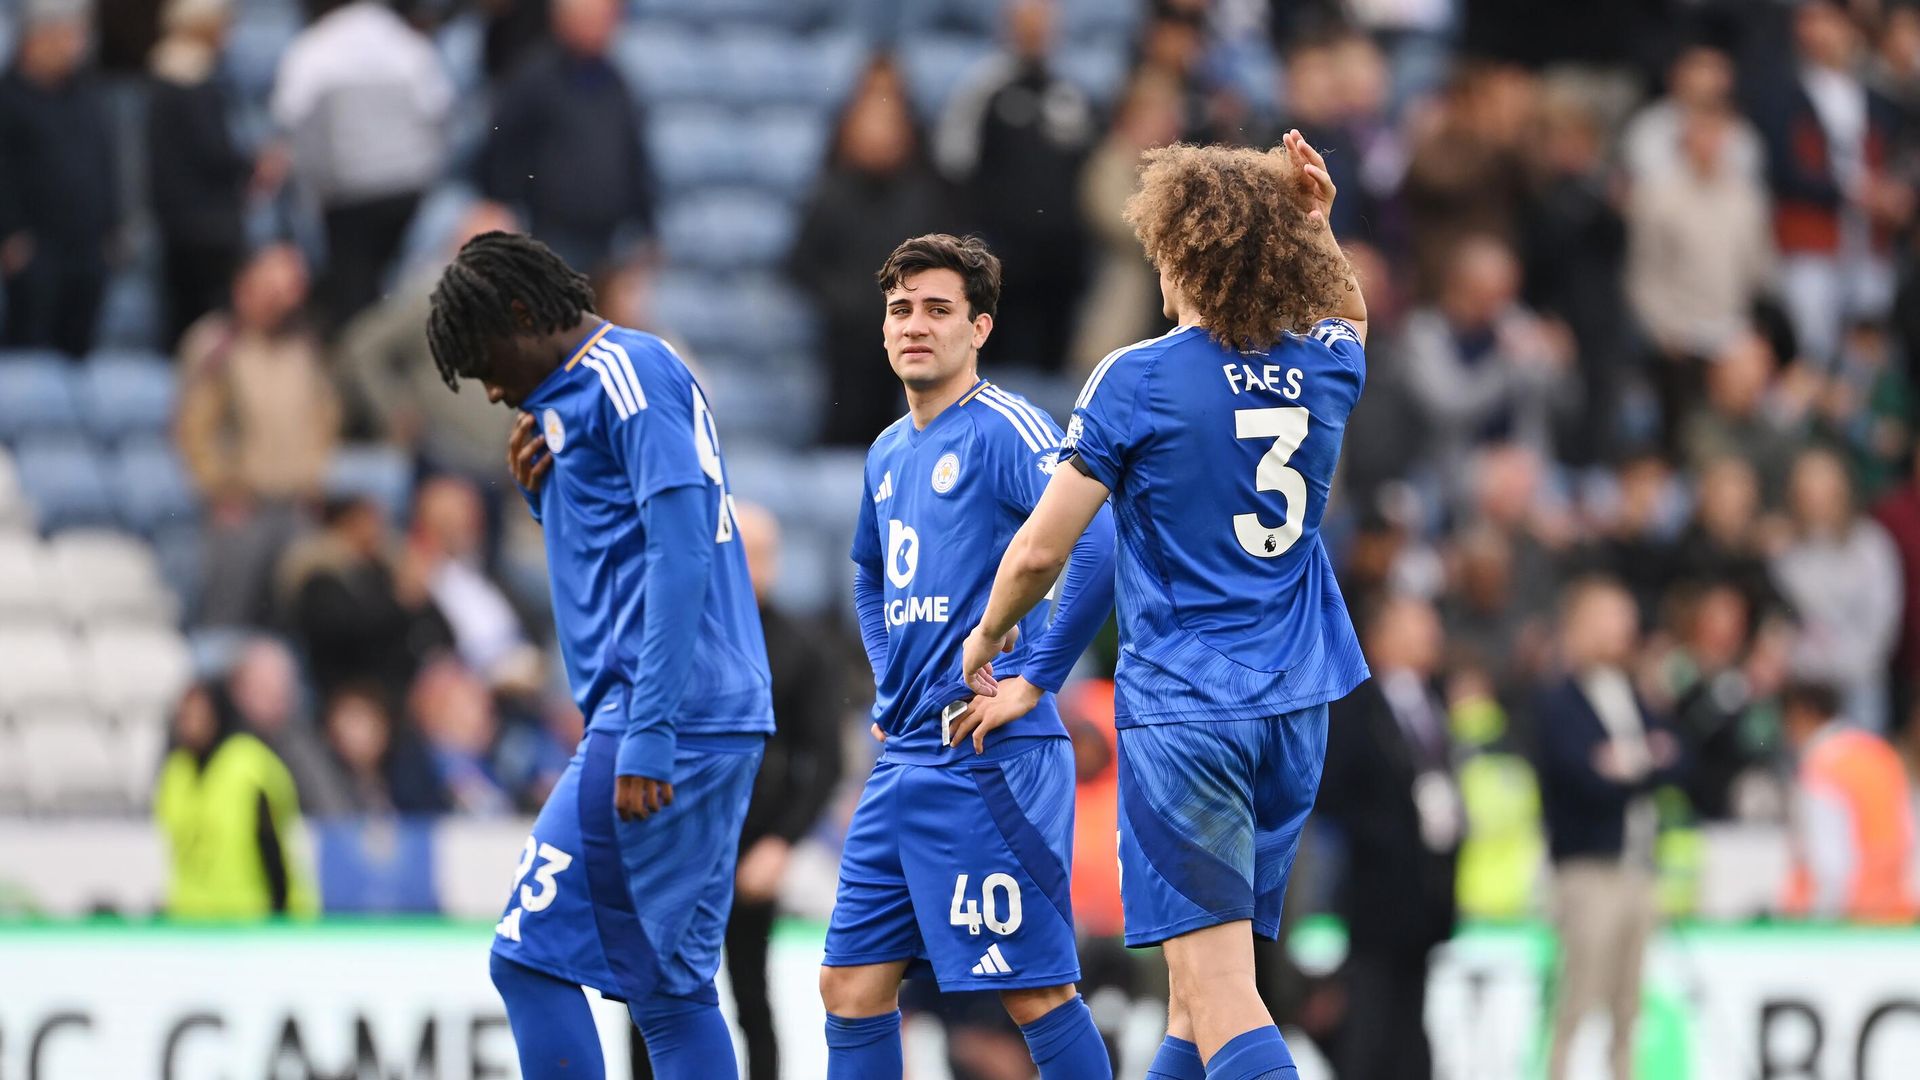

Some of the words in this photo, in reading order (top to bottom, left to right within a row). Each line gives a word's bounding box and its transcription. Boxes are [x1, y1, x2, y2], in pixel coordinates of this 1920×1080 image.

[1223, 363, 1304, 400] FAES
[1233, 406, 1310, 558] 3
[950, 872, 1023, 936] 40
